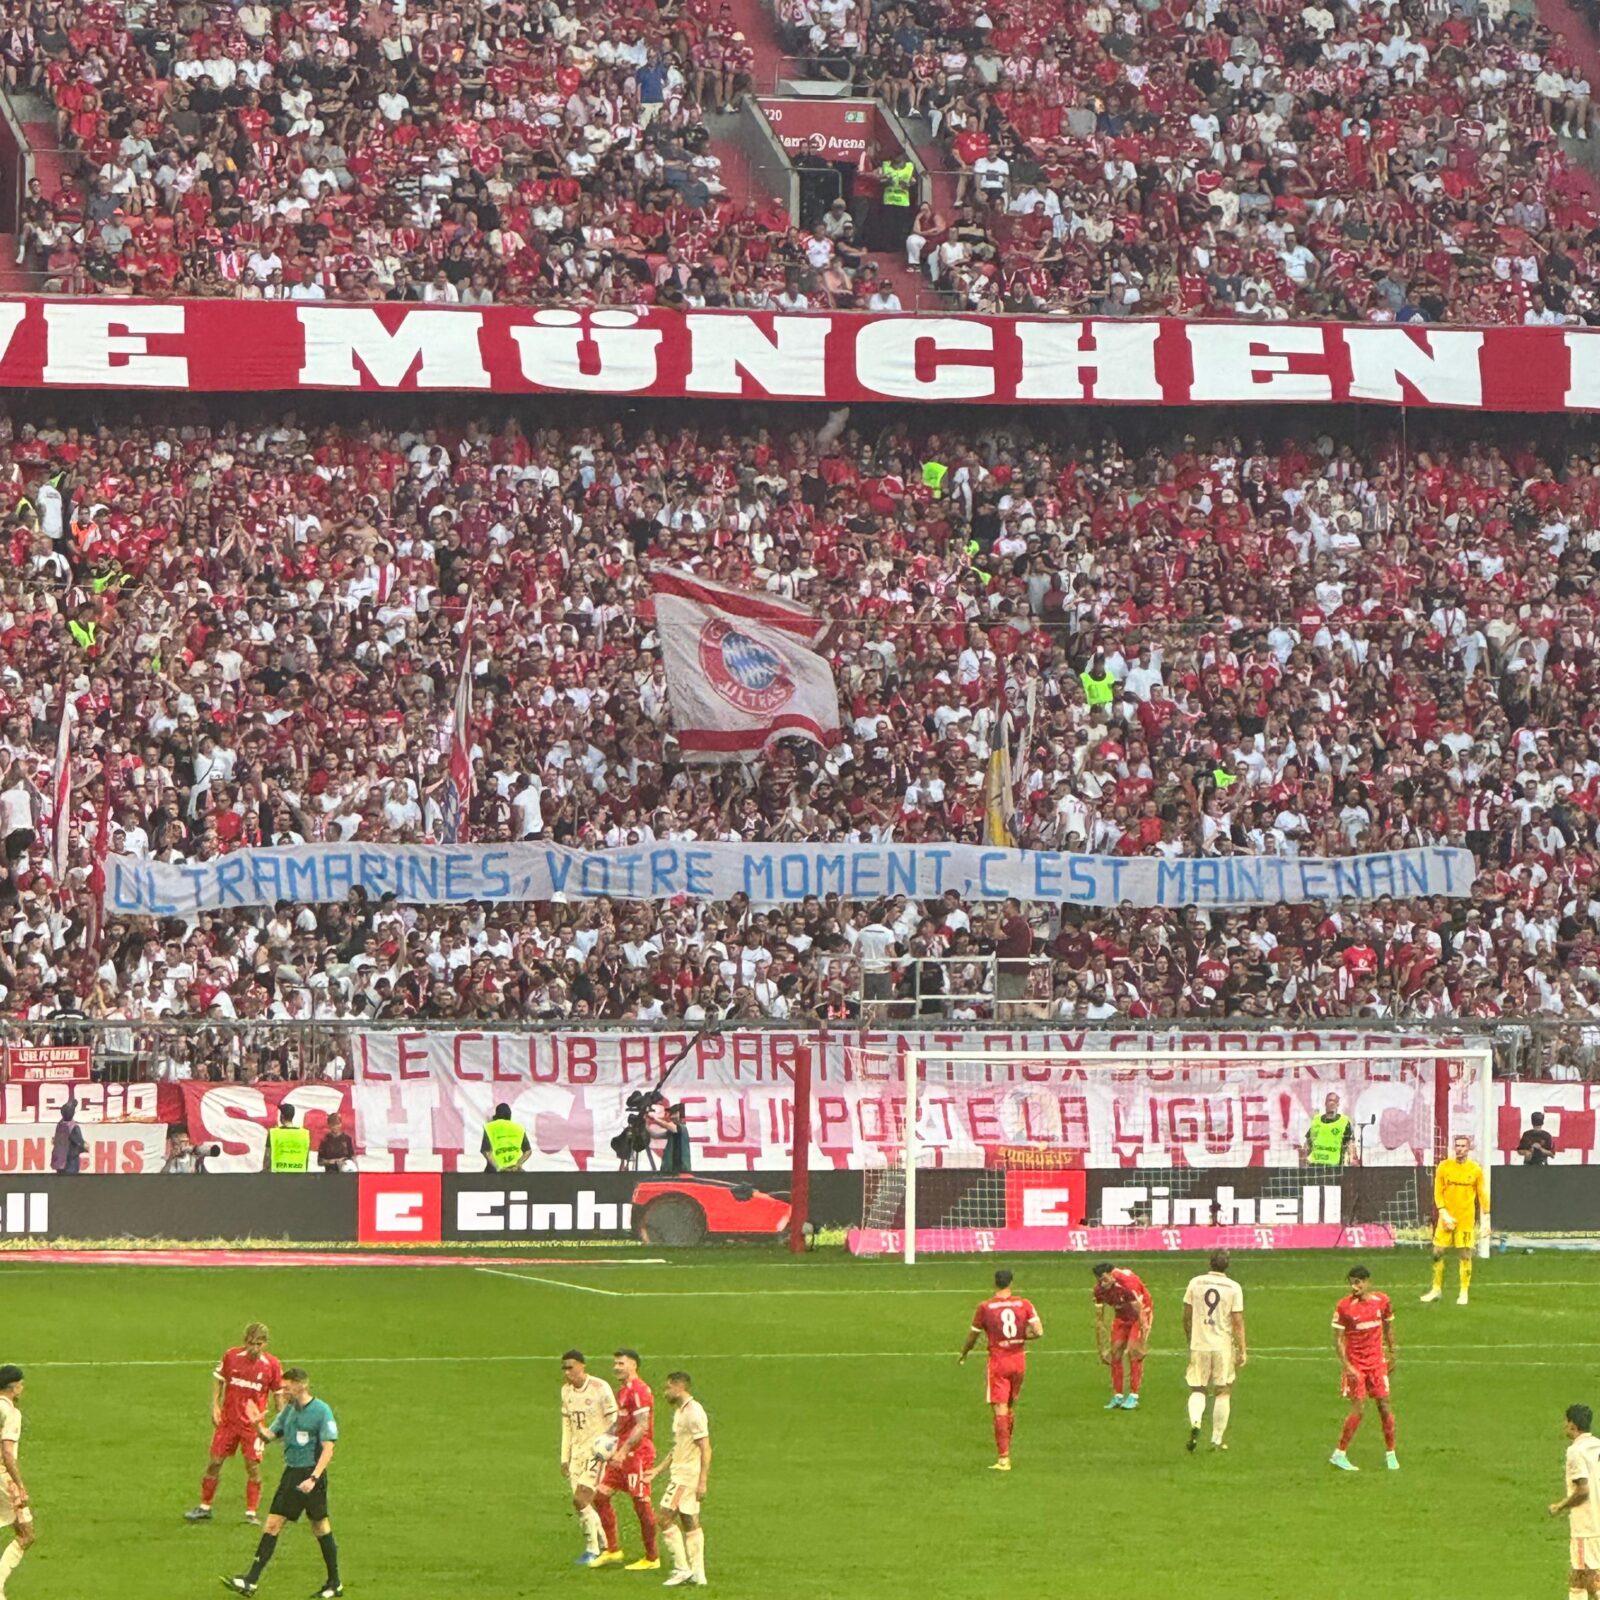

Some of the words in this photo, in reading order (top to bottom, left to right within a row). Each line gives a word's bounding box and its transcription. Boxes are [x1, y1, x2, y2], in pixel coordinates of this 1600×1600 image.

[829, 136, 866, 149] Arena
[296, 305, 1484, 406] MÜNCHEN
[545, 849, 713, 898] VOTRE
[980, 848, 1129, 901] C'EST
[1157, 848, 1460, 907] MAINTENANT
[360, 1032, 430, 1080] LE
[453, 1033, 598, 1083] CLUB
[619, 1031, 964, 1083] APPARTIENT
[983, 1034, 1088, 1082] AUX
[1024, 1096, 1090, 1142] LA
[457, 1191, 632, 1230] Einh
[1102, 1185, 1341, 1226] Einhell
[1000, 1307, 1017, 1339] 8
[1204, 1288, 1221, 1317] 9
